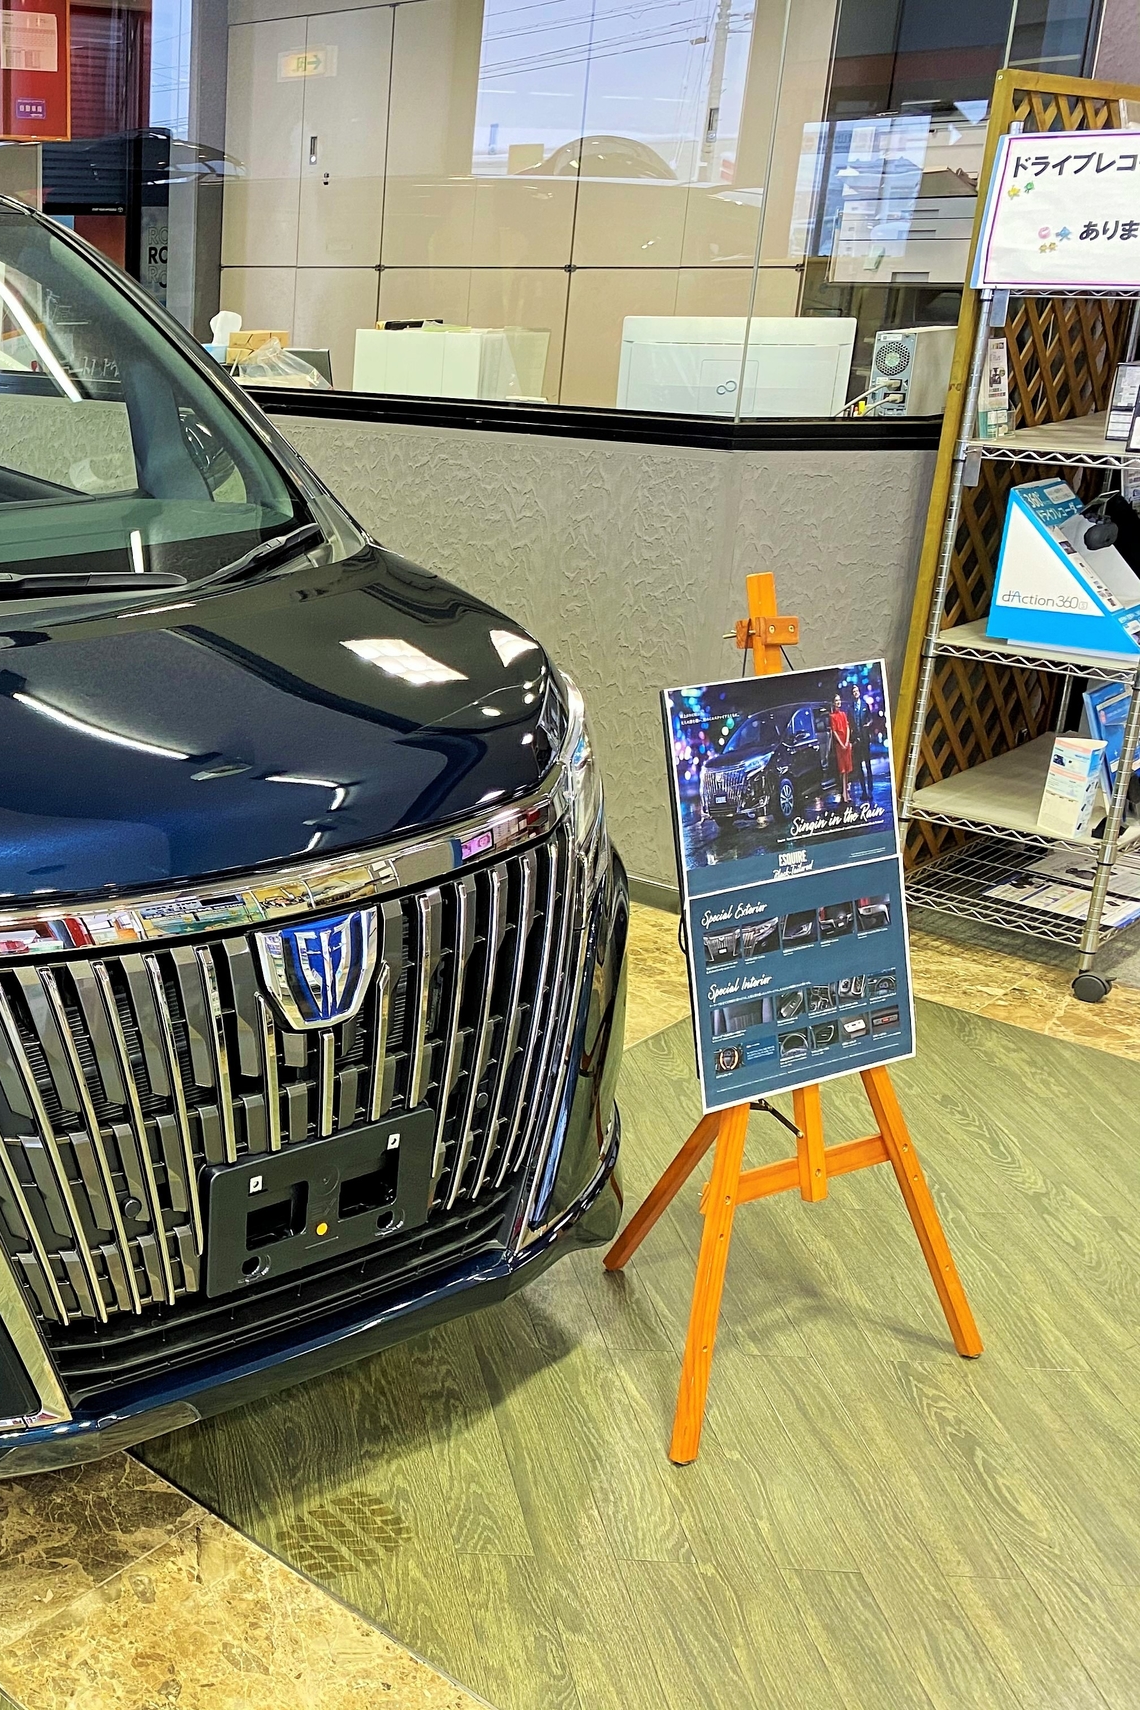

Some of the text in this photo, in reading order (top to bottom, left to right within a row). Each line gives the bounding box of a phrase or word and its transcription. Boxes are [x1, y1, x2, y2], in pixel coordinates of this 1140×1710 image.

[1013, 151, 1140, 178] ドライブレコ
[1079, 220, 1140, 241] ありま
[828, 812, 843, 826] in
[843, 806, 859, 824] the
[860, 802, 885, 822] Rain
[779, 850, 808, 867] ESQUIRE
[701, 901, 768, 929] Special Exterior
[707, 977, 740, 1003] Special
[741, 973, 773, 990] Interior
